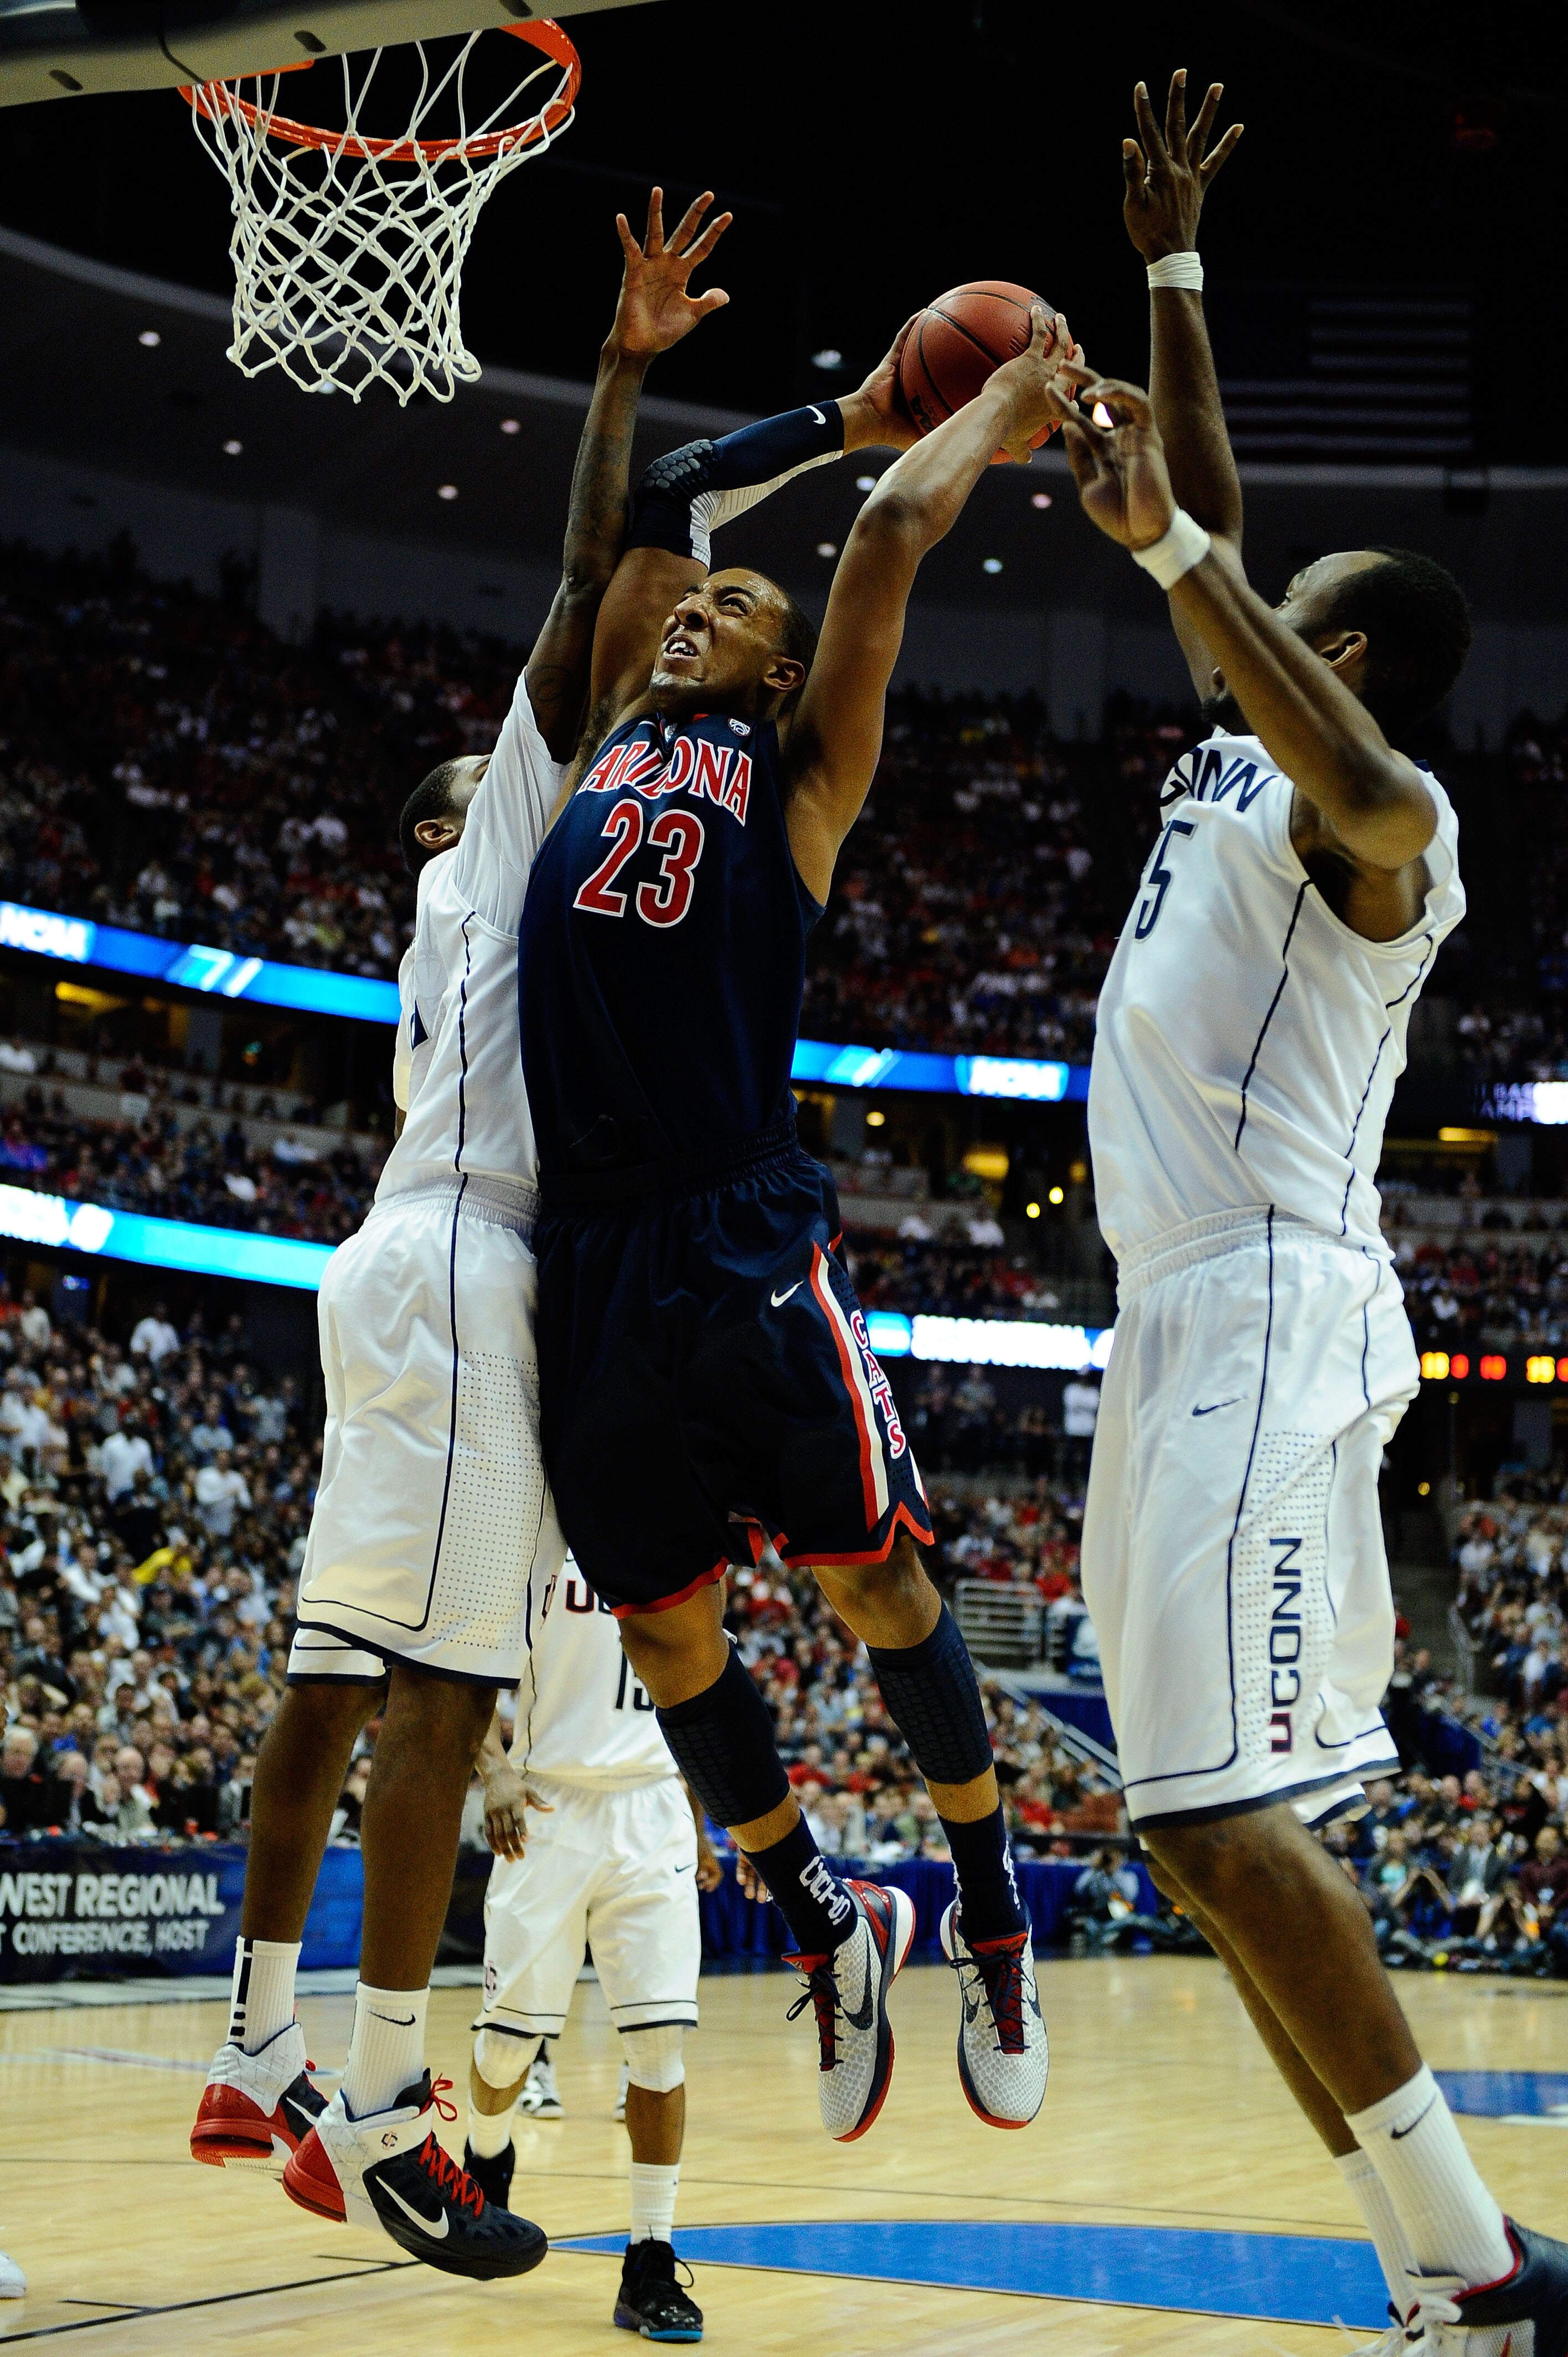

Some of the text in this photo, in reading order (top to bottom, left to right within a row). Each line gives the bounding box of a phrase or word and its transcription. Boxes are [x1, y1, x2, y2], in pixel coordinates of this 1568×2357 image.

[572, 799, 705, 928] 23
[850, 1309, 906, 1459] CATS
[1269, 1537, 1302, 1753] UCONN
[75, 1872, 226, 1917] REGIONAL
[156, 1918, 210, 1951] HOST
